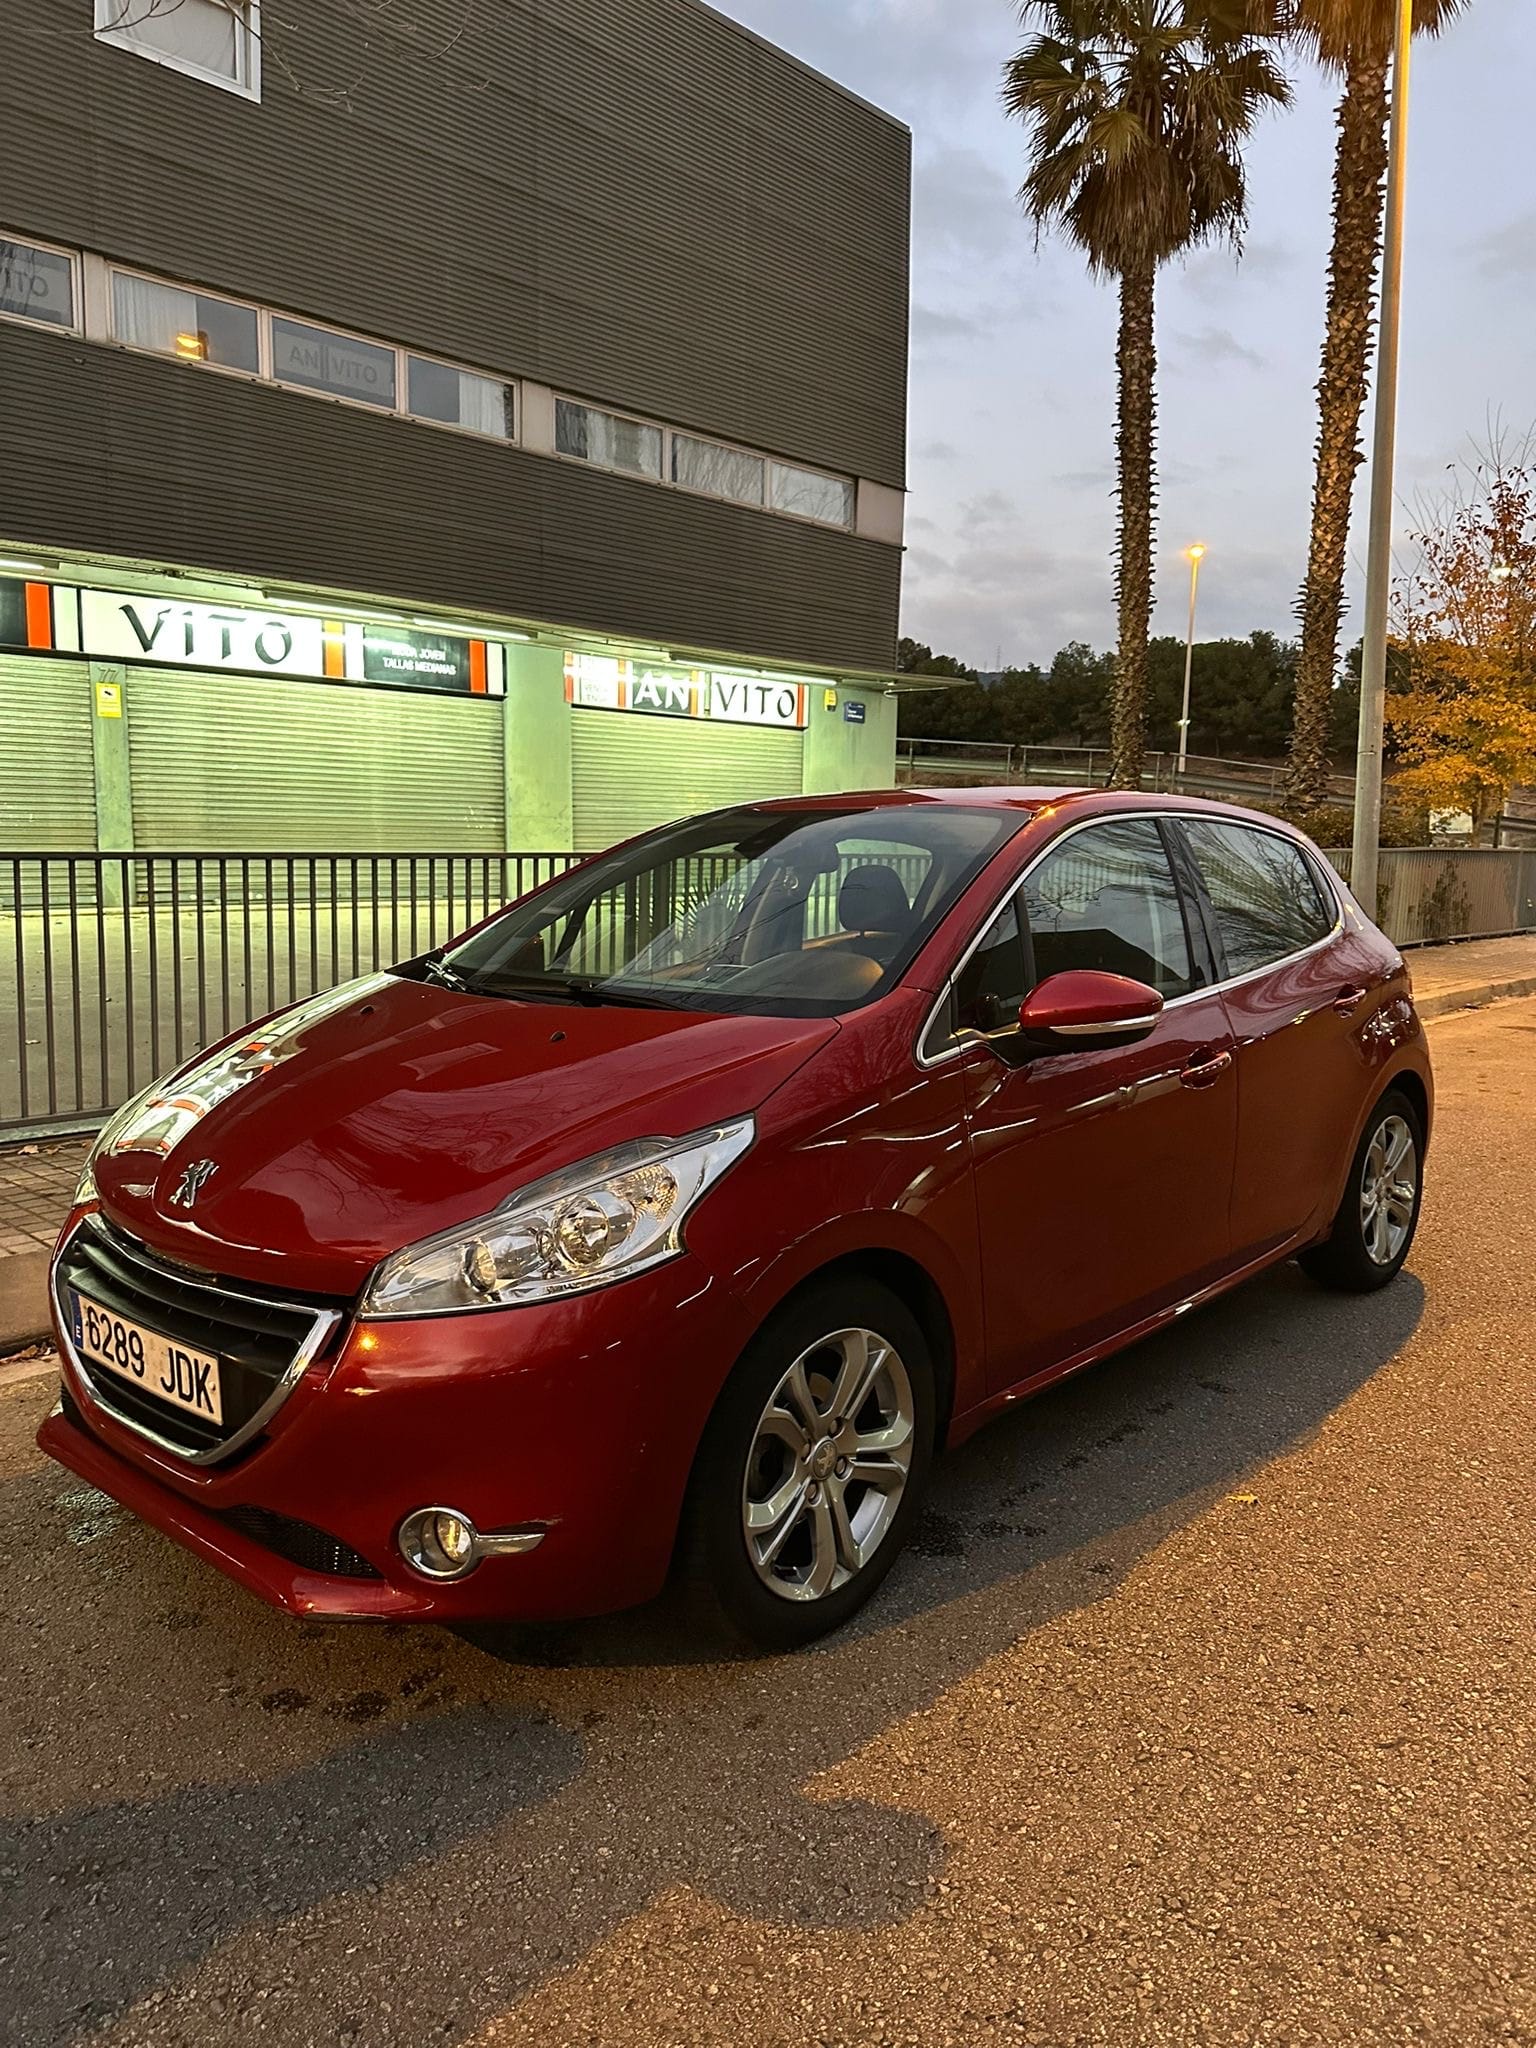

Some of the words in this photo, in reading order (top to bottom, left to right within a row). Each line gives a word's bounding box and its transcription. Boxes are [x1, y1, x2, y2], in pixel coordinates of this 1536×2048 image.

[0, 266, 49, 297] ITO
[332, 356, 377, 383] VITO
[118, 604, 292, 665] VITO
[382, 656, 414, 671] TALLAS
[634, 671, 690, 710] AN
[715, 681, 795, 718] VITO
[87, 1306, 145, 1378] 6289
[160, 1347, 214, 1414] JDK
